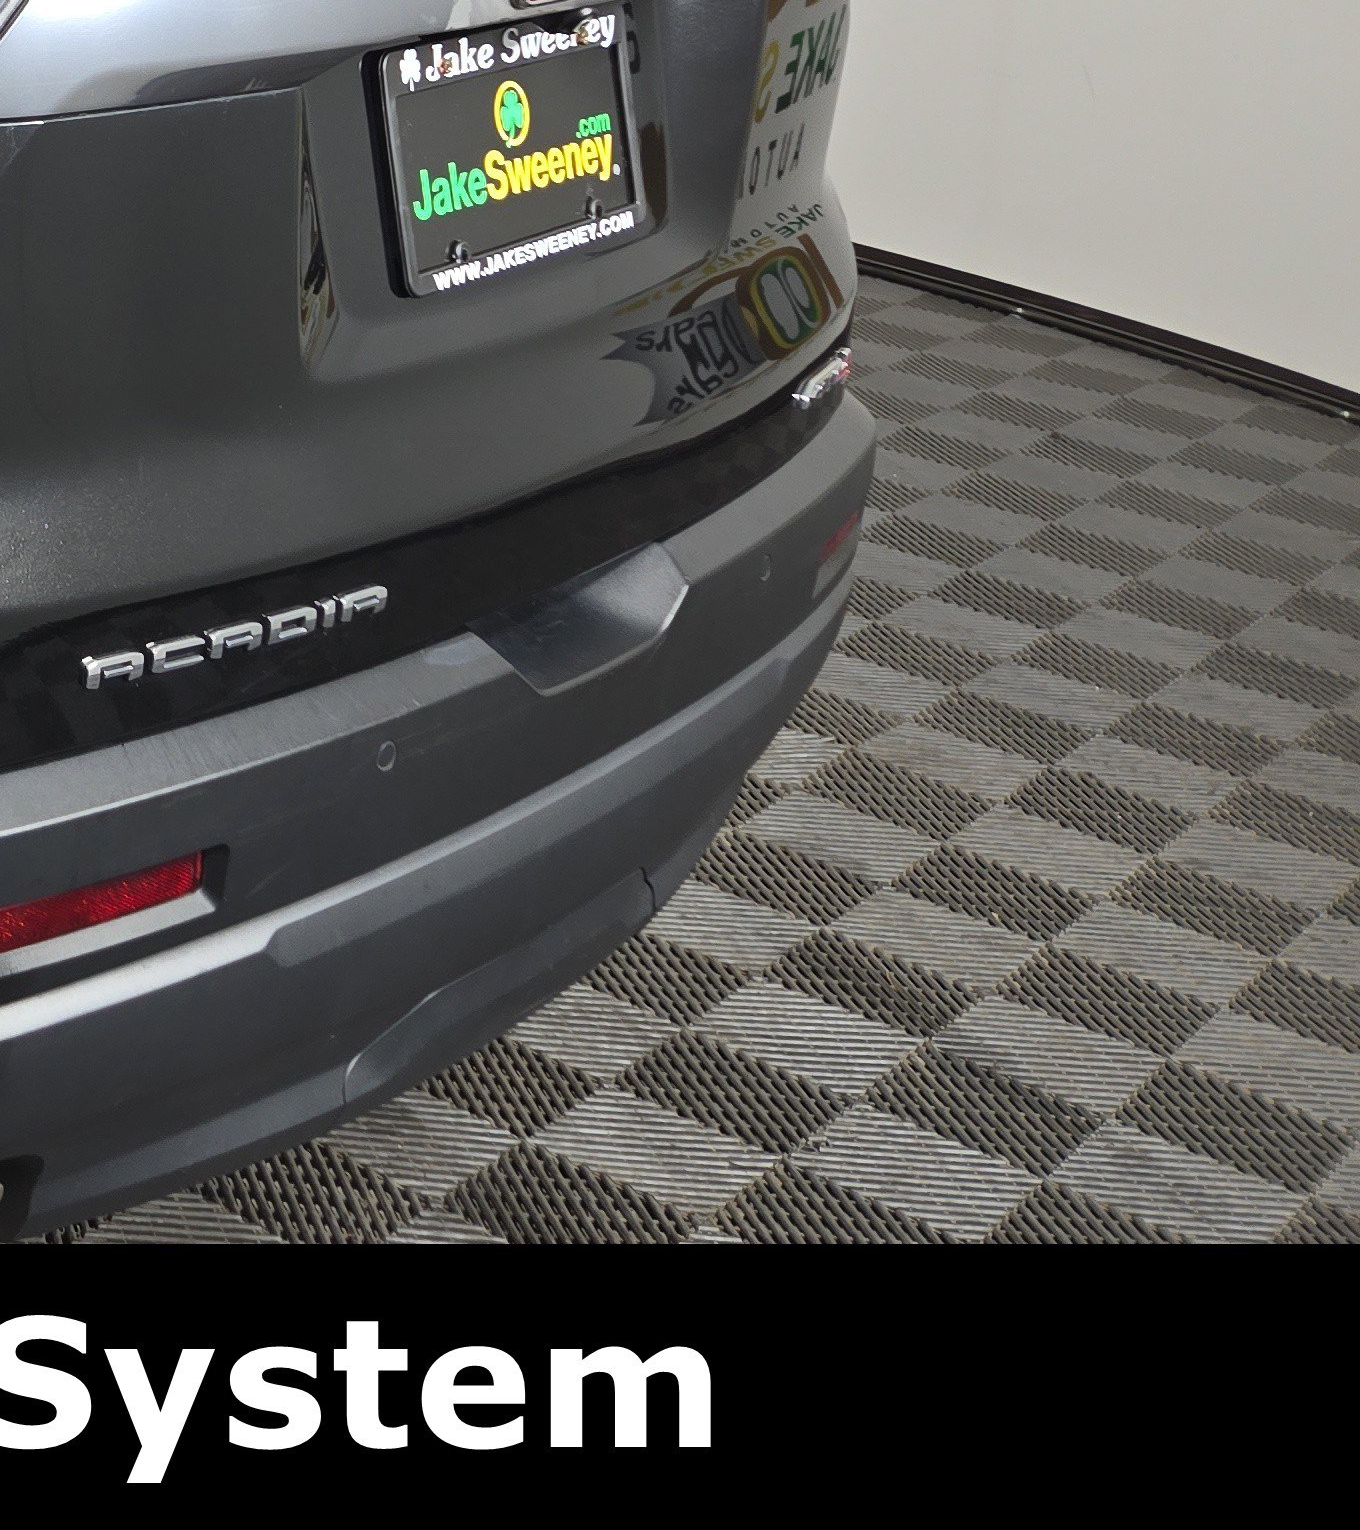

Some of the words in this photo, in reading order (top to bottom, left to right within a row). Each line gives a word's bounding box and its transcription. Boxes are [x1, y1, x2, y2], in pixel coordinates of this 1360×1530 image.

[425, 37, 495, 82] Jake
[431, 210, 635, 291] WWW.JAKESWEENEY.COM
[81, 585, 388, 690] ACADIA
